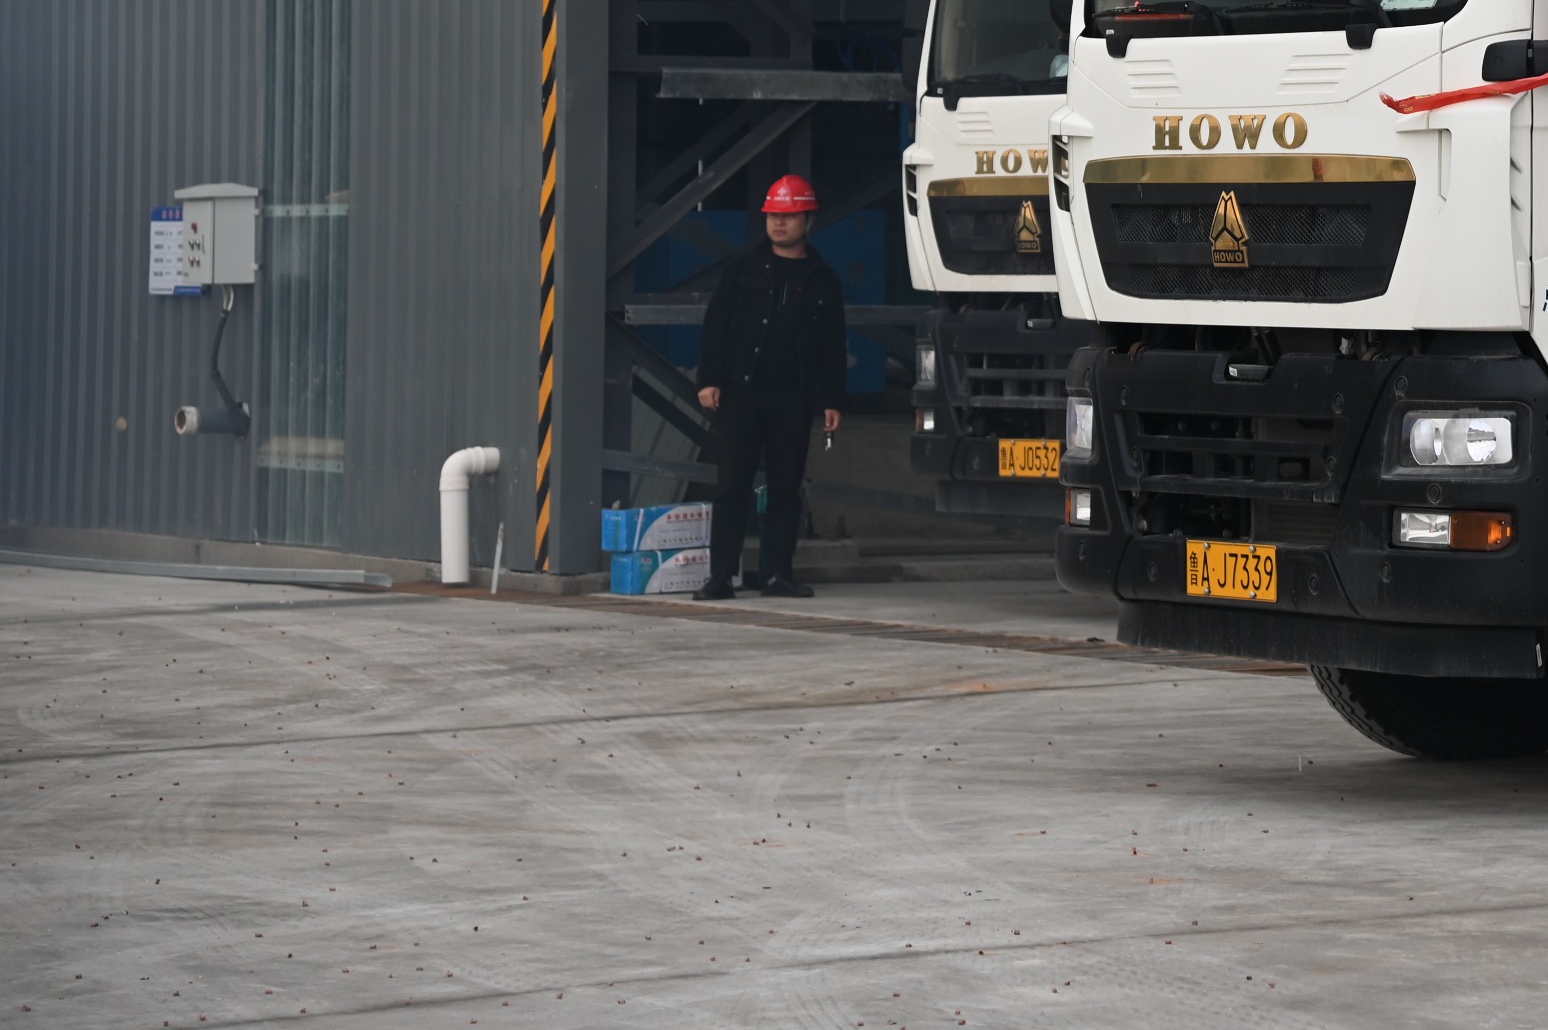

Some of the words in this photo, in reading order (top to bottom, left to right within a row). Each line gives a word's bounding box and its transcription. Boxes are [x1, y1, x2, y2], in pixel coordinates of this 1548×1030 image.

[1152, 112, 1308, 151] HOWO
[975, 148, 1050, 175] HOW
[1214, 251, 1243, 263] HOWO
